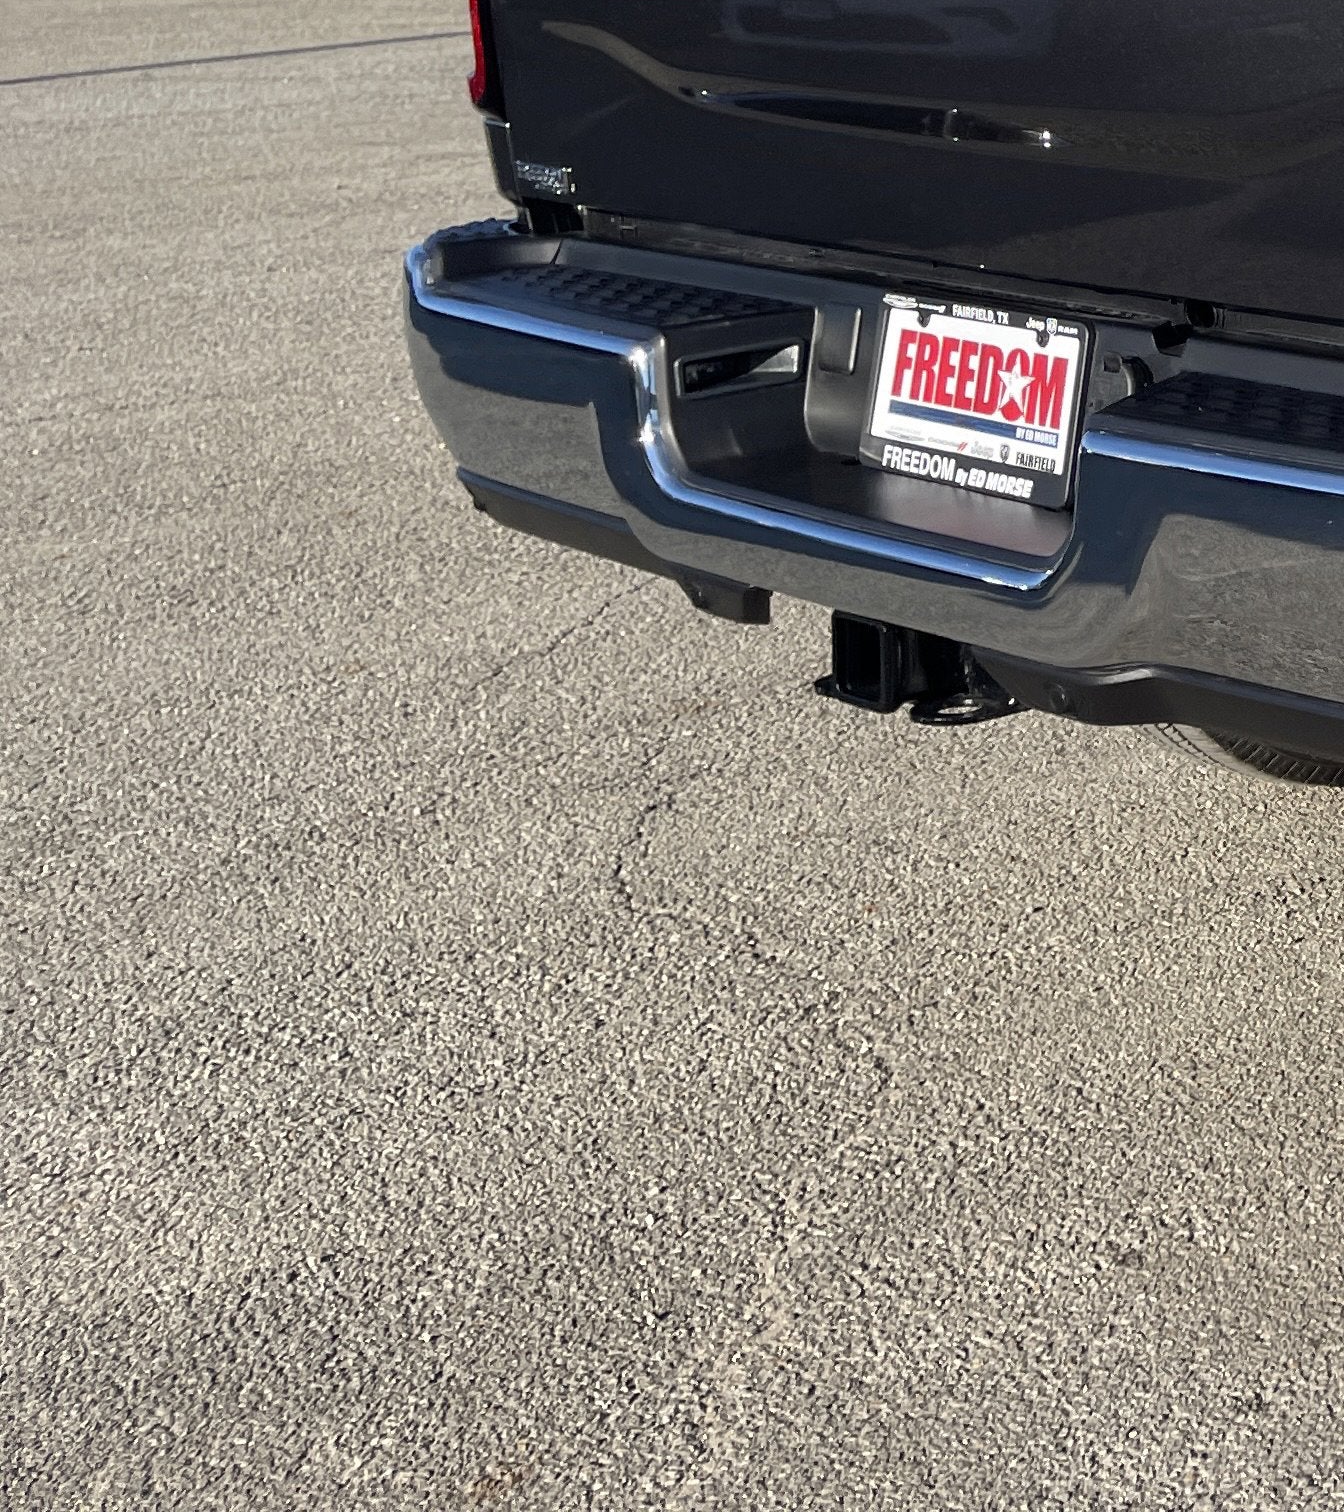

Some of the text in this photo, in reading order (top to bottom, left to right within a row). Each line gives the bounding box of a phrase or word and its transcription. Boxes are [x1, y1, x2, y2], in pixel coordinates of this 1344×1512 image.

[952, 304, 996, 324] FAIRFIELD,
[996, 311, 1009, 325] TX
[890, 328, 1069, 430] FREEDOM
[1015, 427, 1058, 447] BY ED MORSE
[881, 444, 956, 482] FREEDOM
[967, 467, 987, 488] ED
[985, 471, 1034, 499] MORSE
[1015, 452, 1056, 473] FAIRFIELD
